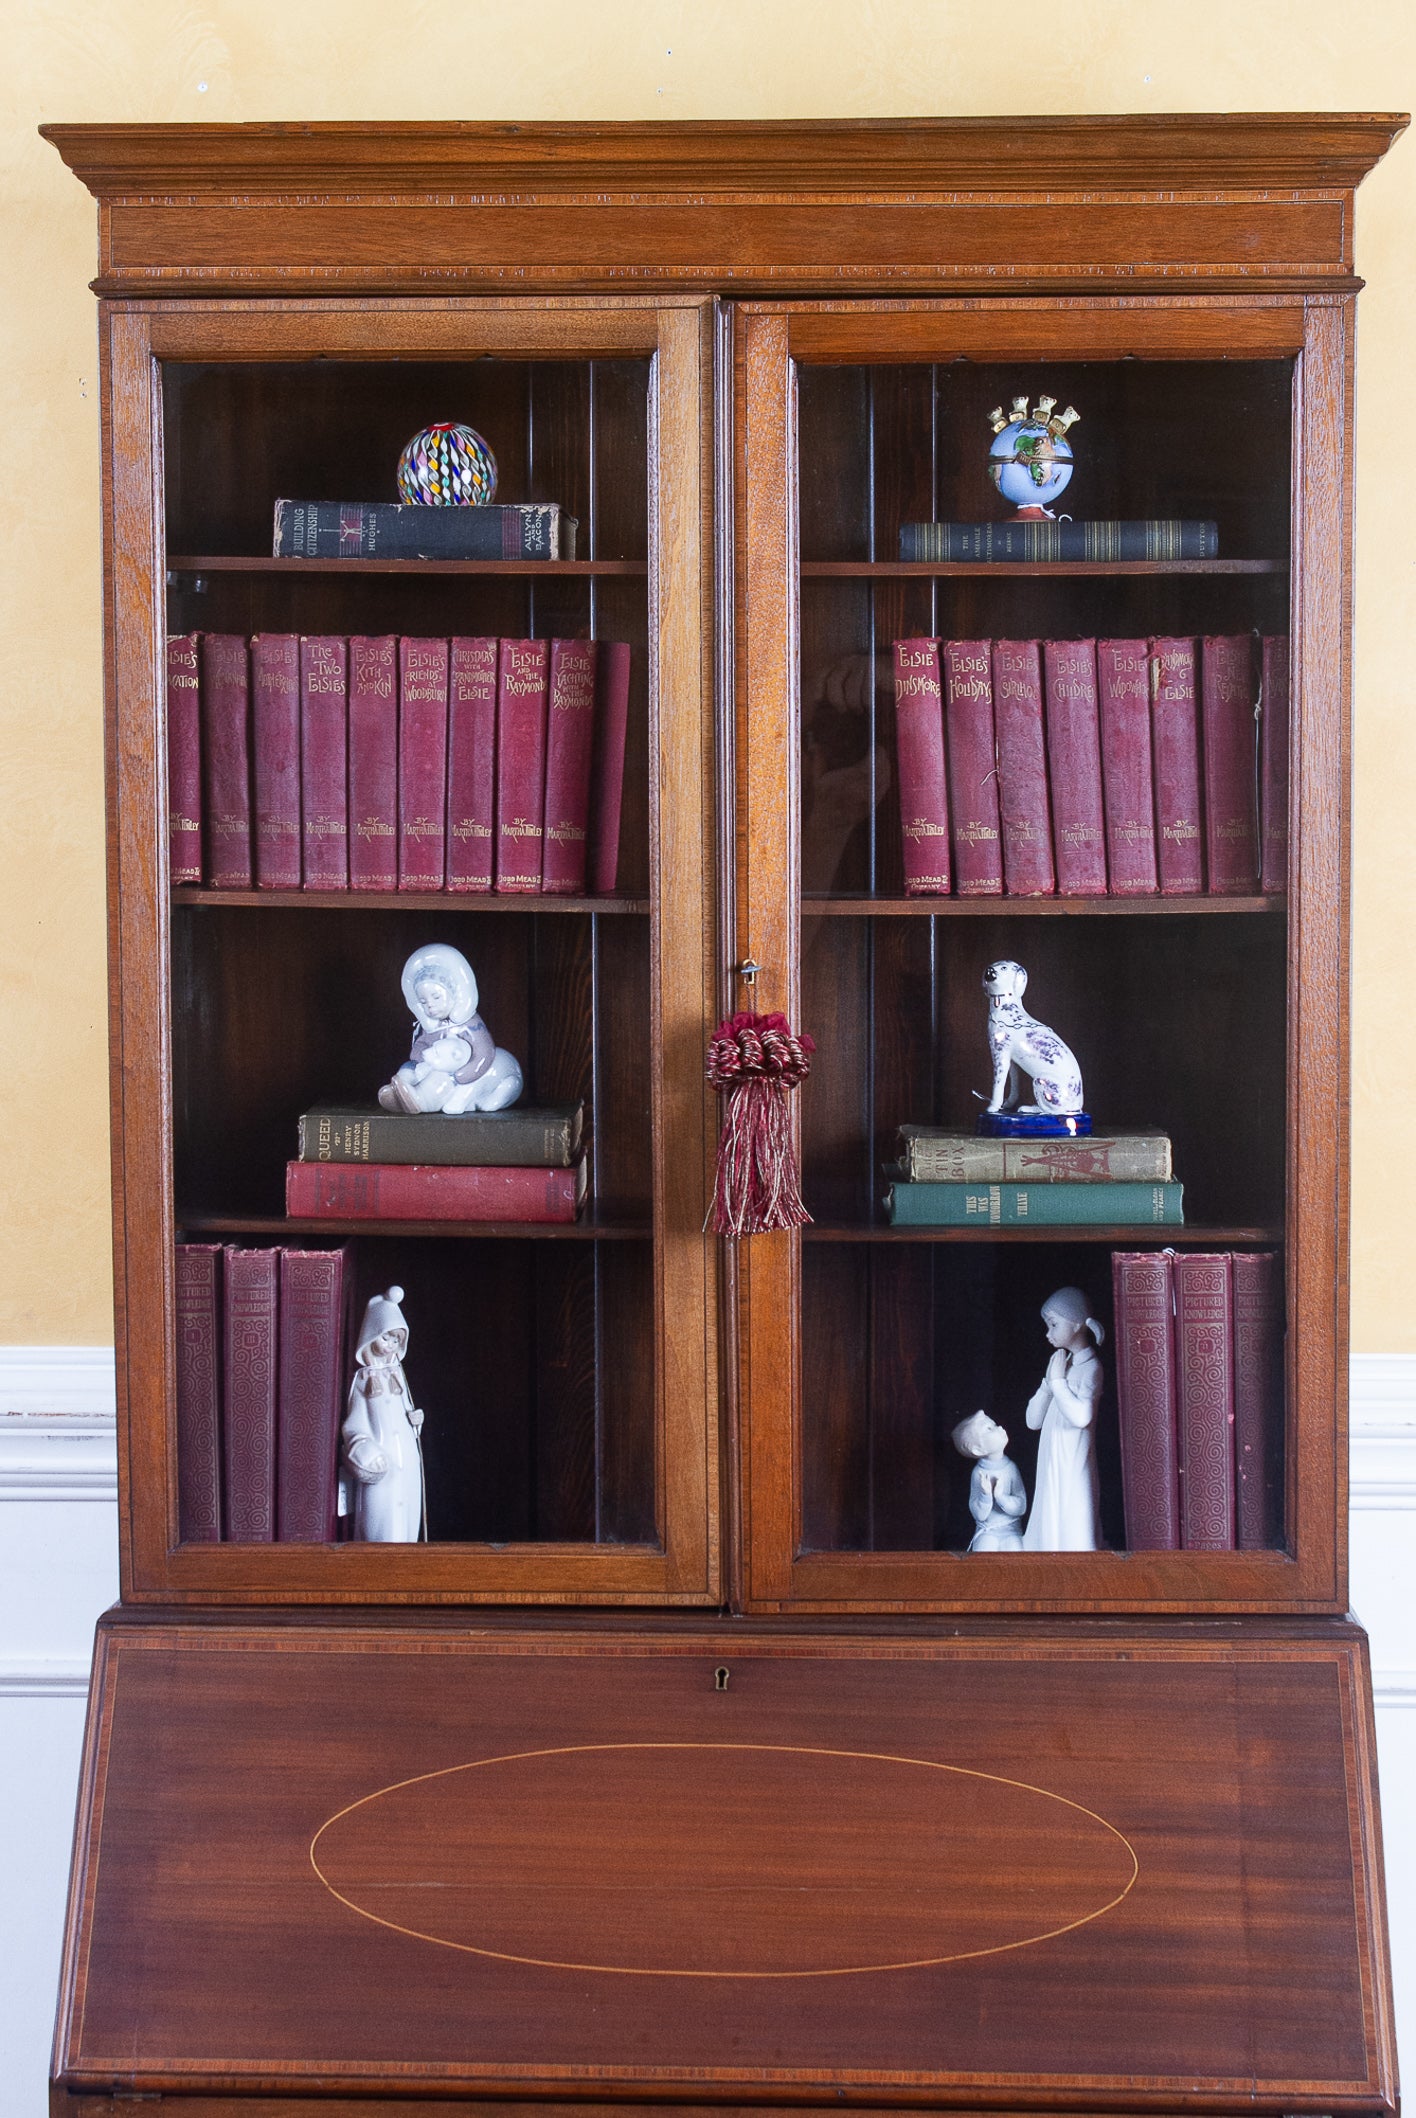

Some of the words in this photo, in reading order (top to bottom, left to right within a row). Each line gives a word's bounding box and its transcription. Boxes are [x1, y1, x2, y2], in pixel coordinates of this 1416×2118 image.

[293, 508, 304, 551] BUILDING
[307, 504, 318, 556] CITIZENSHIP
[368, 513, 377, 551] HUGHES
[524, 513, 533, 551] ALLYN
[535, 514, 544, 551] BACON
[169, 650, 198, 669] LSIE'S
[307, 644, 332, 660] The
[408, 649, 446, 671] ELSIE'S
[507, 645, 546, 668] ELSIE
[559, 652, 592, 670] ELSIE
[898, 644, 934, 668] ELSIE
[516, 667, 530, 675] AND
[949, 650, 988, 675] ELSIE'S
[1054, 651, 1093, 678] ELSIE'S
[356, 664, 380, 682] KITH
[404, 669, 439, 685] FRIENDS
[524, 672, 539, 680] THE
[554, 670, 594, 688] YACHTING
[374, 673, 393, 698] KIN
[404, 685, 447, 703] WOODBURN
[458, 686, 491, 700] ELSIE
[895, 674, 942, 703] DINSMORE
[949, 675, 993, 704] HOLIDAYS
[1164, 680, 1195, 700] ELSIE
[552, 688, 594, 711] RAYMONDS
[460, 818, 475, 826] BY
[418, 874, 439, 882] MEAD
[466, 875, 487, 884] MEAD
[515, 874, 537, 883] MEAD
[921, 876, 941, 884] MEAD
[975, 878, 996, 886] MEAD
[318, 1117, 331, 1161] QUEED
[362, 1121, 370, 1160] HARRISON
[936, 1148, 948, 1174] TIN
[951, 1146, 965, 1178] BOX
[966, 1196, 977, 1215] THIS
[978, 1197, 989, 1212] WAS
[1127, 1297, 1165, 1307] PICTURED
[1185, 1296, 1223, 1307] PICTURED
[1184, 1309, 1224, 1319] KNOWLEDGE
